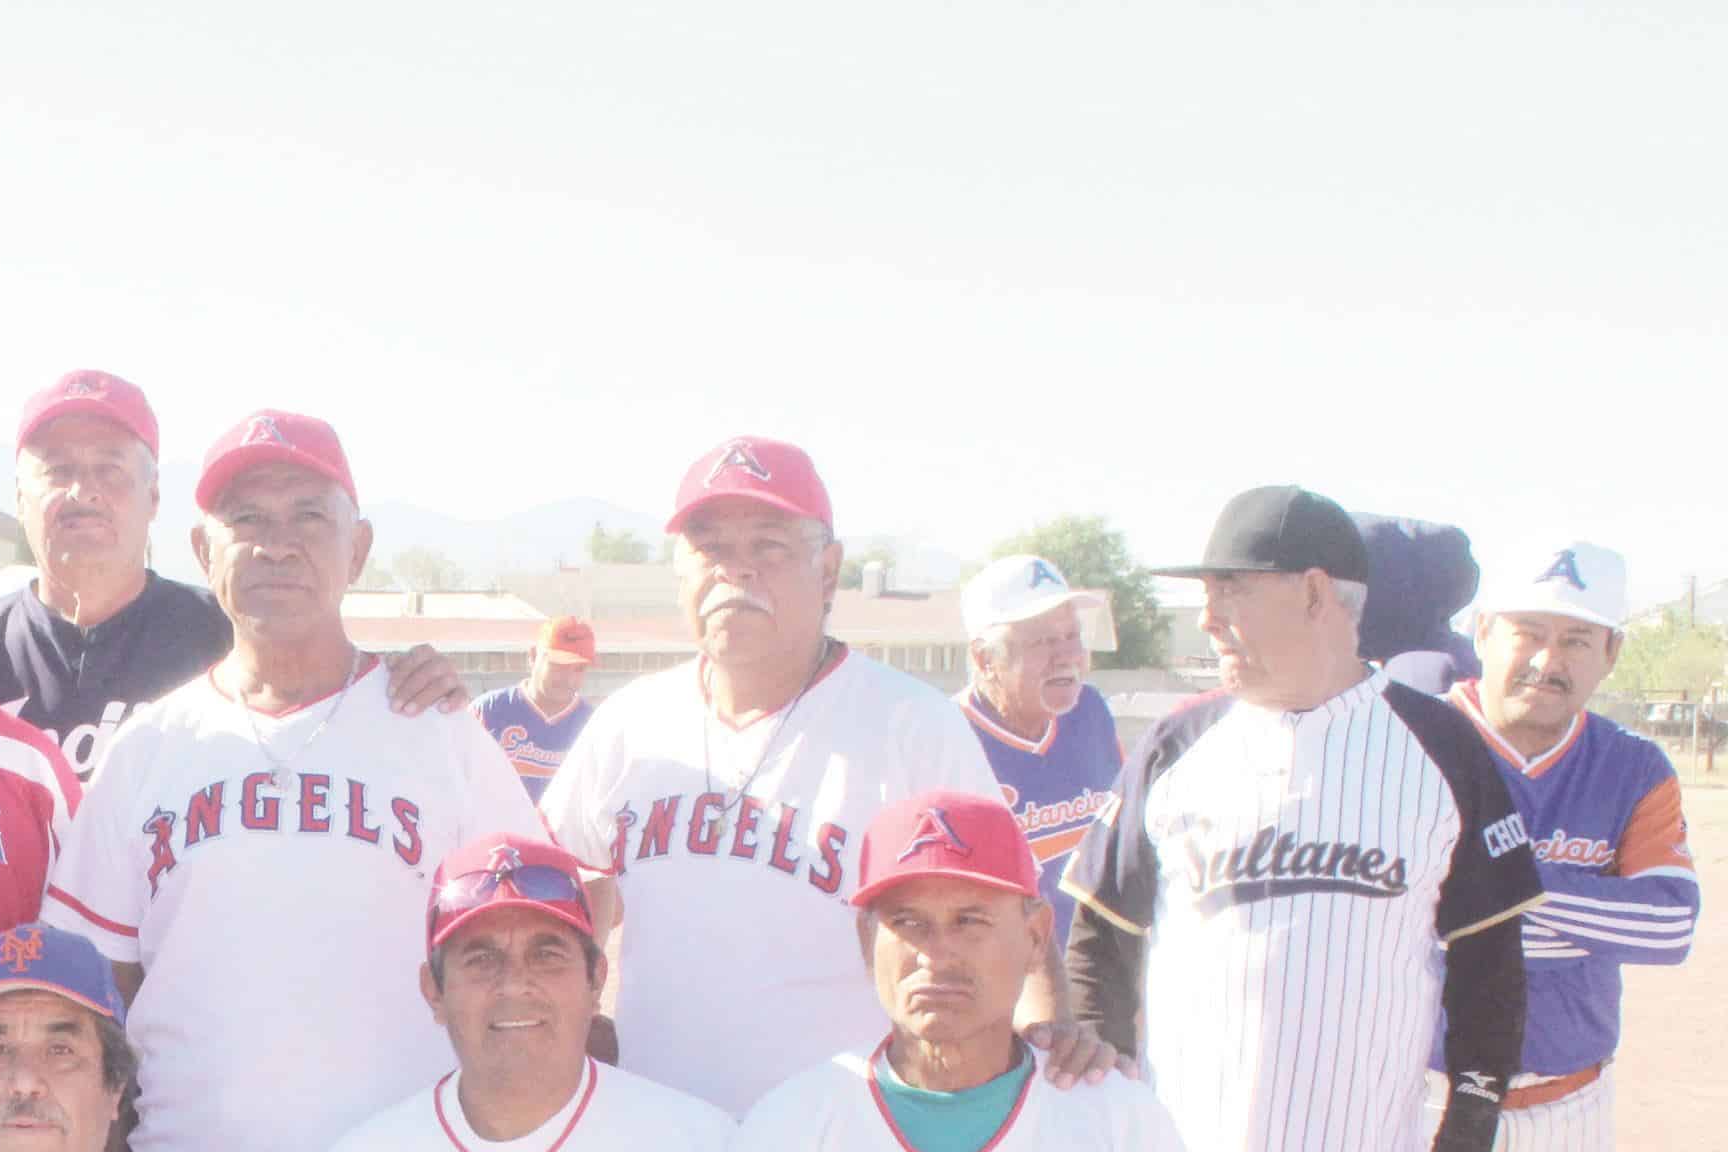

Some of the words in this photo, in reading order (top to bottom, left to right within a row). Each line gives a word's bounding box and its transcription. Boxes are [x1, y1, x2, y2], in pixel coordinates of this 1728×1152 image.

[1533, 547, 1587, 592] A
[142, 772, 423, 901] ANGELS
[608, 791, 849, 895] ANGELS
[1183, 817, 1408, 893] Sultanes
